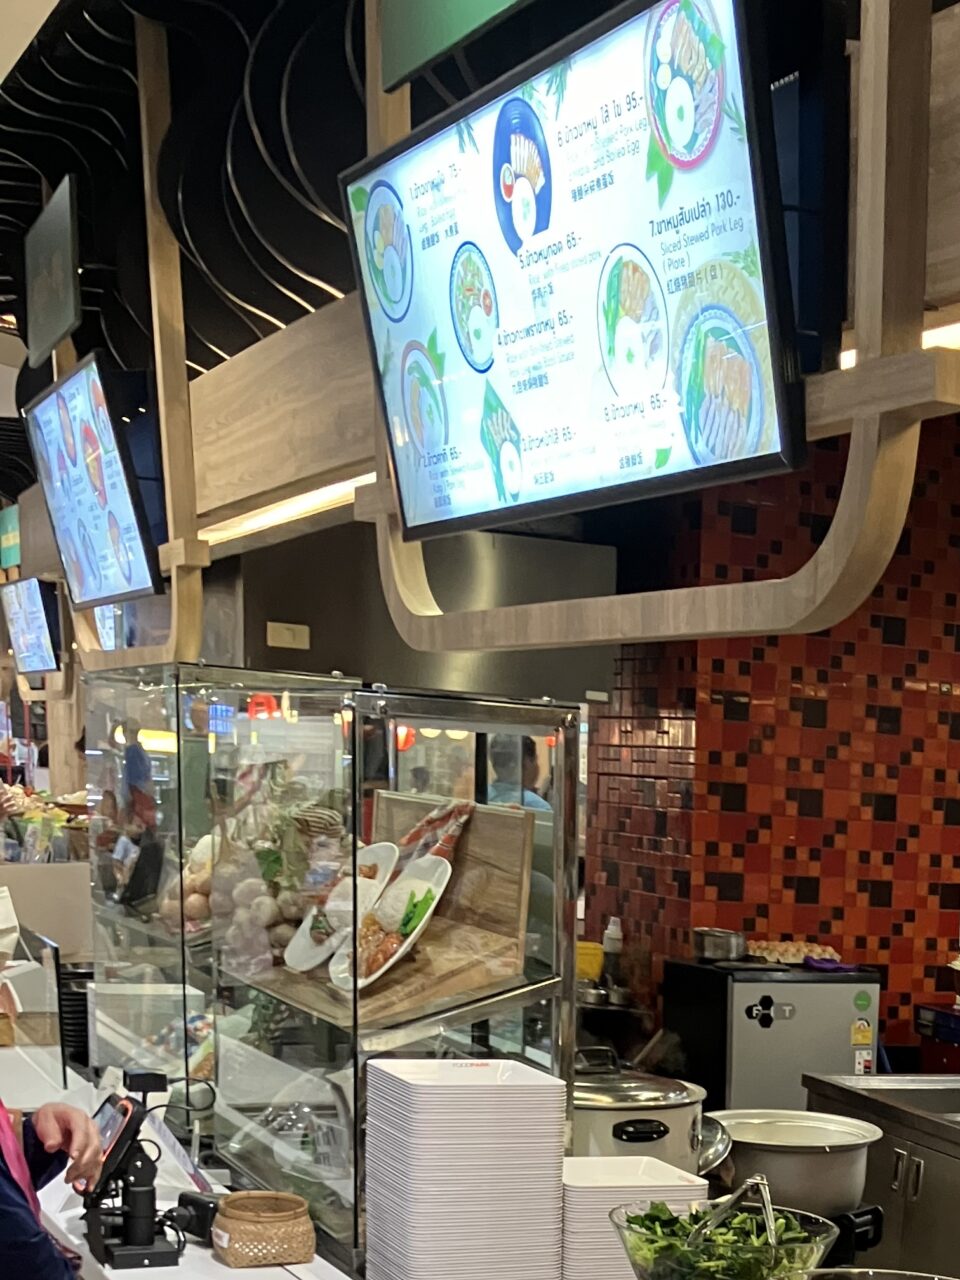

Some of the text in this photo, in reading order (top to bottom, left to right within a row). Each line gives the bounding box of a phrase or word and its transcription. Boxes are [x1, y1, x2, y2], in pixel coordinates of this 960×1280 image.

[715, 189, 741, 213] 130.-
[660, 216, 744, 256] Sliced Stewed Pork Leg
